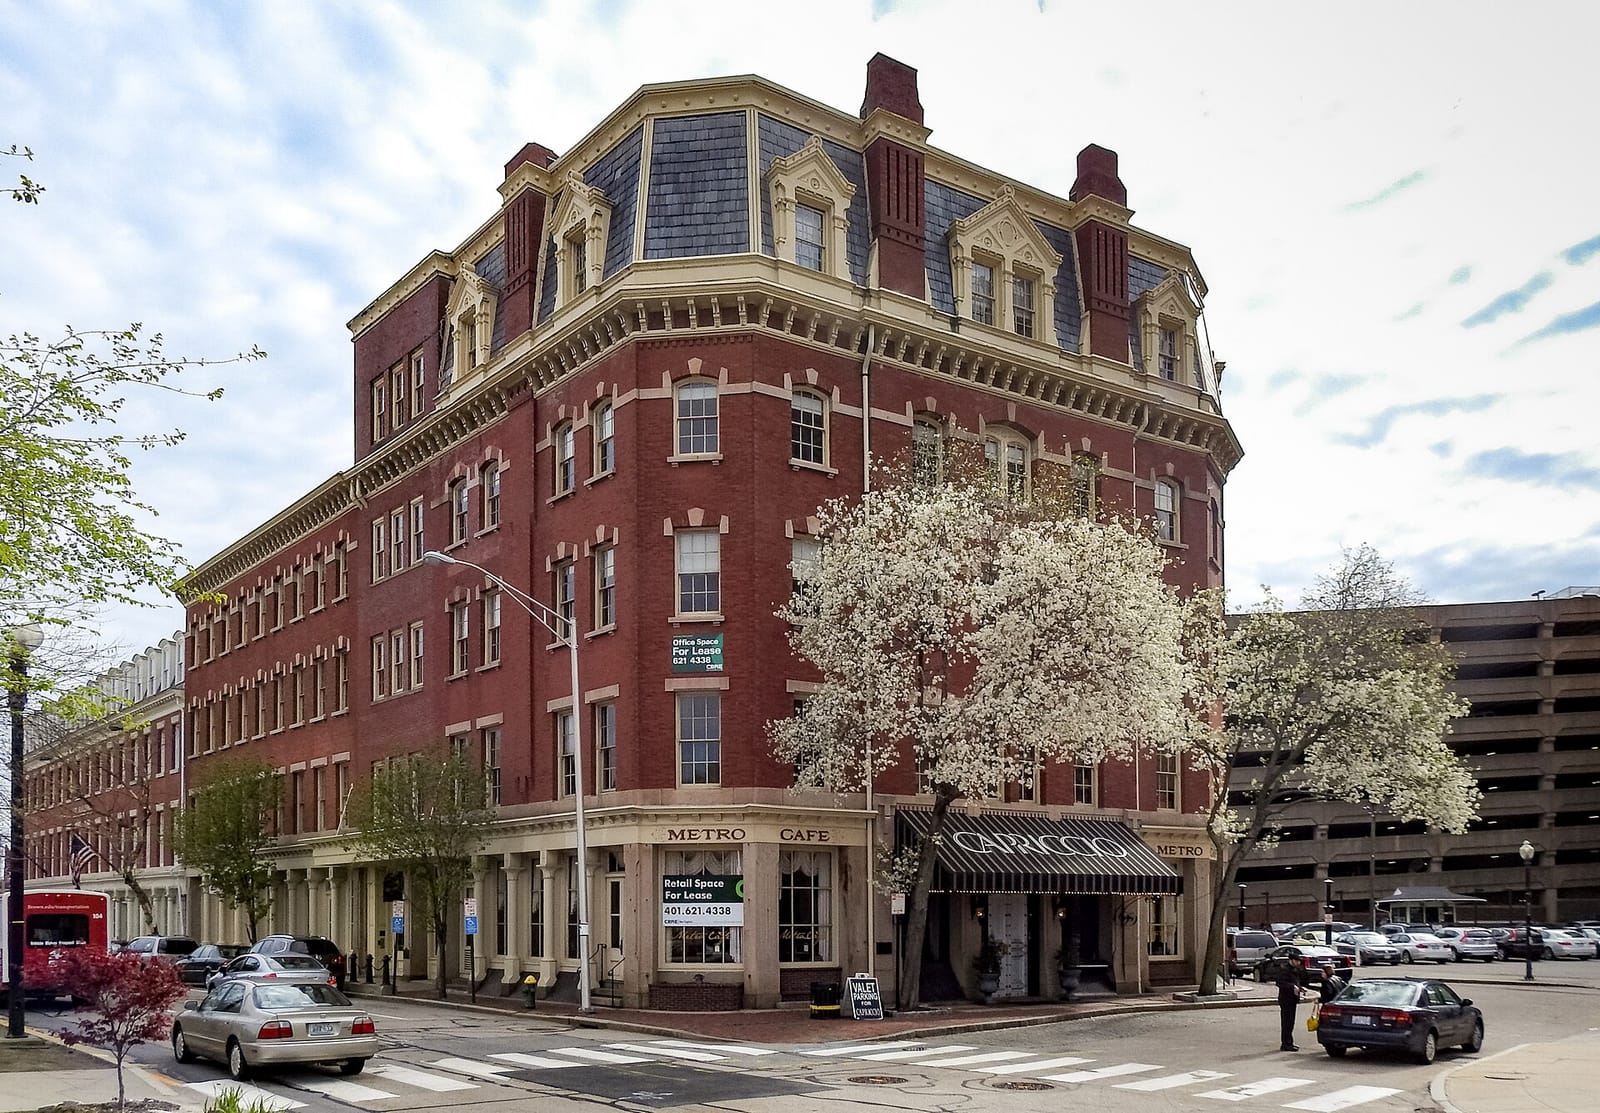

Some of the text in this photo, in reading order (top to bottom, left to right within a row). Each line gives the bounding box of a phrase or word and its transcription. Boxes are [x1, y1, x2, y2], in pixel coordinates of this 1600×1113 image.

[672, 646, 721, 656] For Lease
[667, 828, 746, 841] METRO
[780, 828, 830, 842] CAFE
[952, 831, 1128, 858] CAPRICCIO
[1157, 846, 1203, 856] METRO
[664, 879, 724, 890] Retail Space
[666, 891, 712, 900] For Lease
[664, 906, 732, 915] 401.621.4338
[852, 982, 875, 992] VALET
